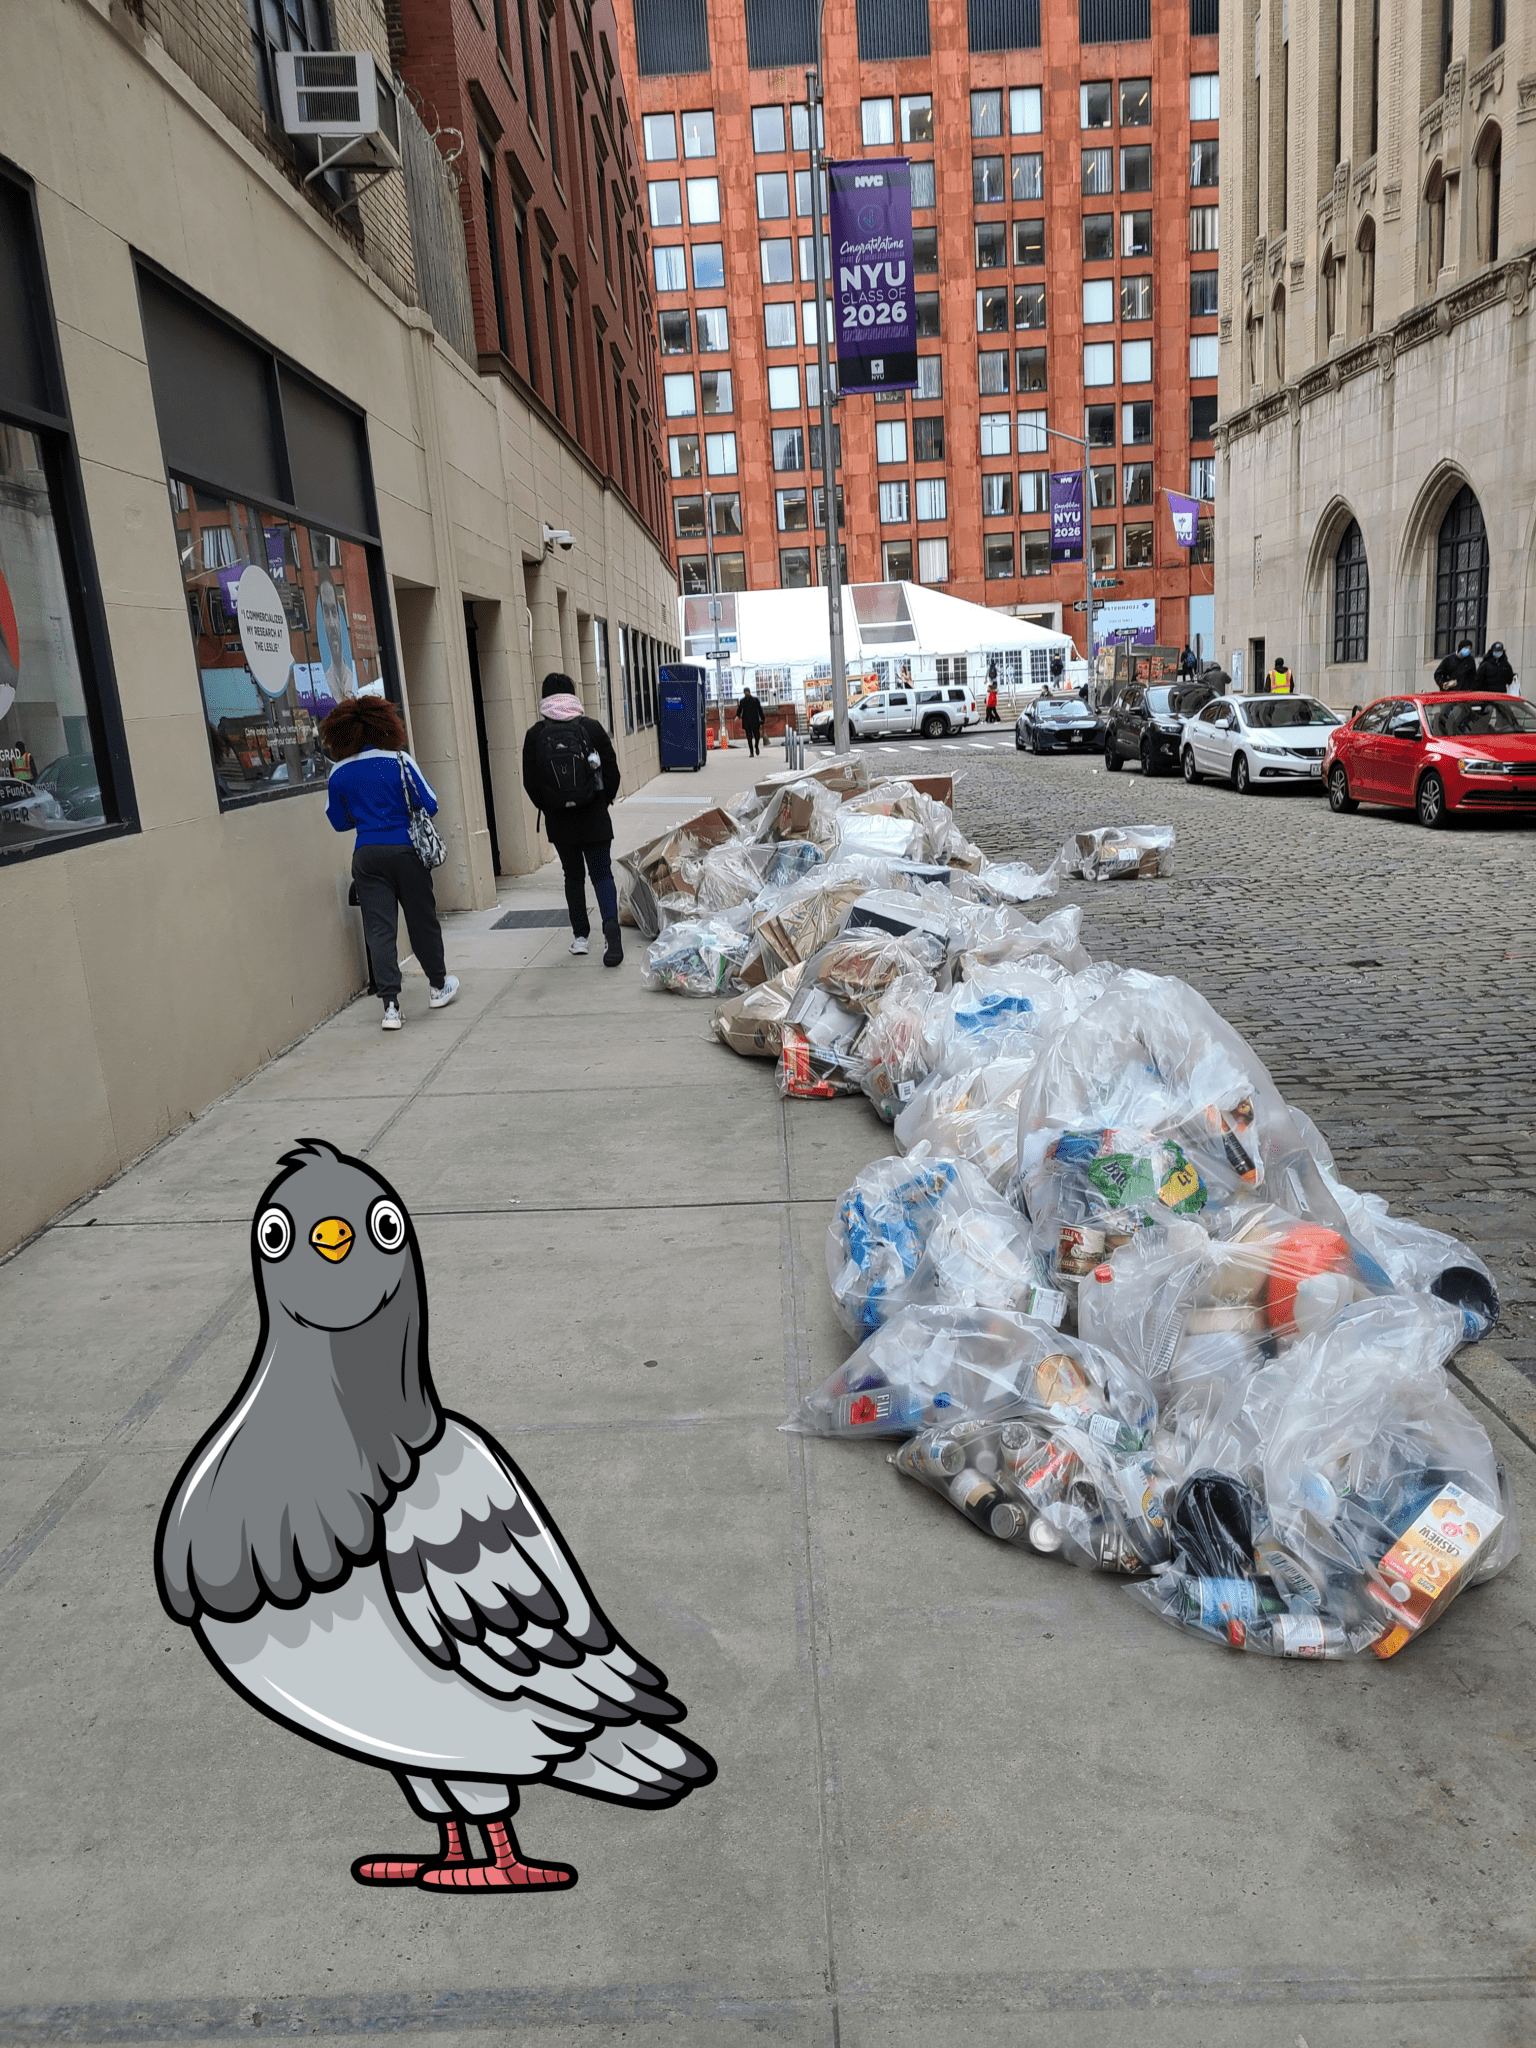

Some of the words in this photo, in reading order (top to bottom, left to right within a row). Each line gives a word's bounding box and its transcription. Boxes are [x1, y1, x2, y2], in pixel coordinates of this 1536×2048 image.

[855, 175, 883, 188] NYC
[840, 236, 904, 263] Congratulations
[840, 260, 906, 291] NYU
[841, 289, 884, 305] CLASS
[888, 287, 906, 300] OF
[843, 301, 907, 328] 2026
[871, 373, 885, 381] NYU
[1054, 511, 1081, 524] NYU
[1054, 527, 1081, 538] 2026
[246, 610, 284, 625] COMMERCIALIZED
[246, 625, 254, 636] MY
[254, 626, 277, 638] RESEARCH
[277, 629, 283, 638] AT
[254, 641, 264, 652] THE
[244, 727, 255, 737] Come
[0, 748, 21, 761] GRAD
[6, 784, 25, 798] Fund
[25, 780, 58, 794] Company
[876, 1393, 890, 1418] FIJI
[1419, 1527, 1460, 1557] CASHEW
[1401, 1544, 1452, 1578] Silk
